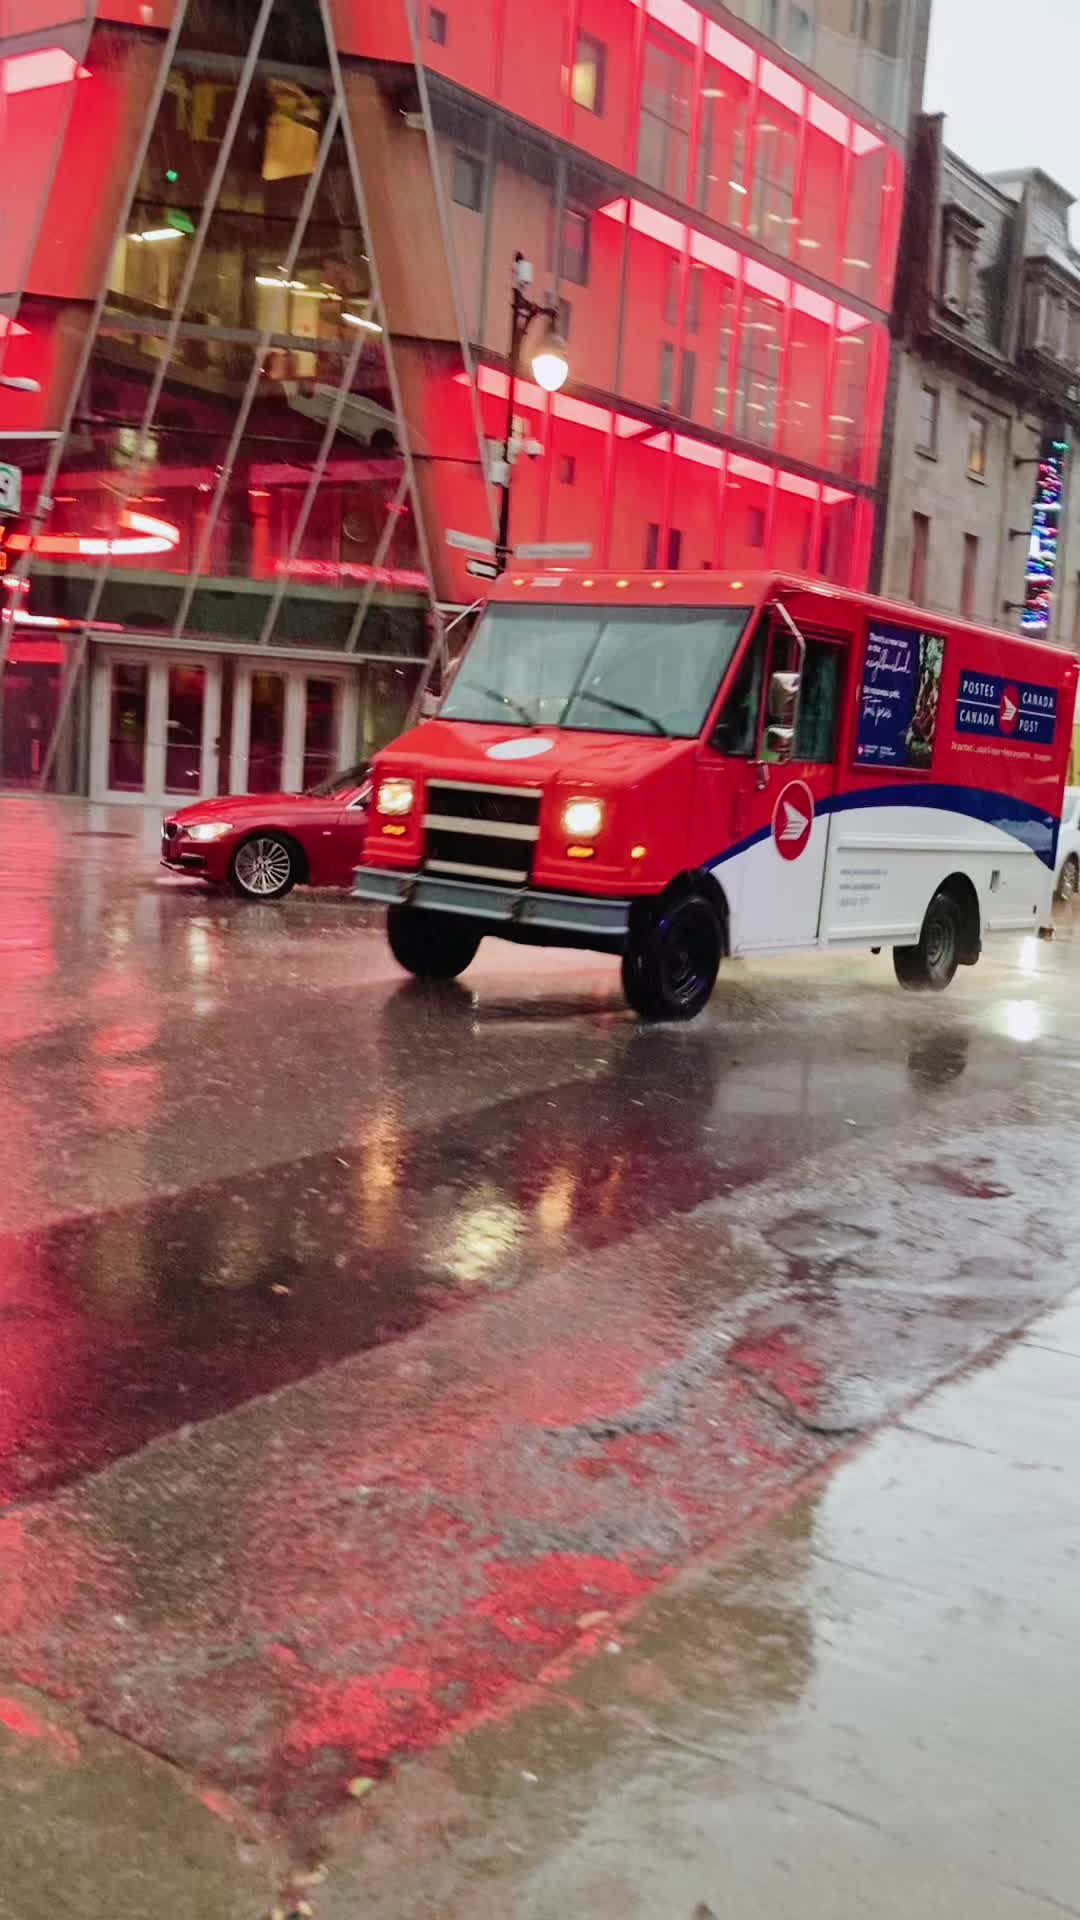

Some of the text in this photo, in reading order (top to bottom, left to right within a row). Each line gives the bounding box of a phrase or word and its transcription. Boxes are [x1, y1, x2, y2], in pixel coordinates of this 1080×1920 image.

[962, 680, 995, 698] POSTES
[1022, 691, 1054, 708] CANADA
[959, 709, 995, 727] CANADA
[1018, 719, 1039, 733] POST
